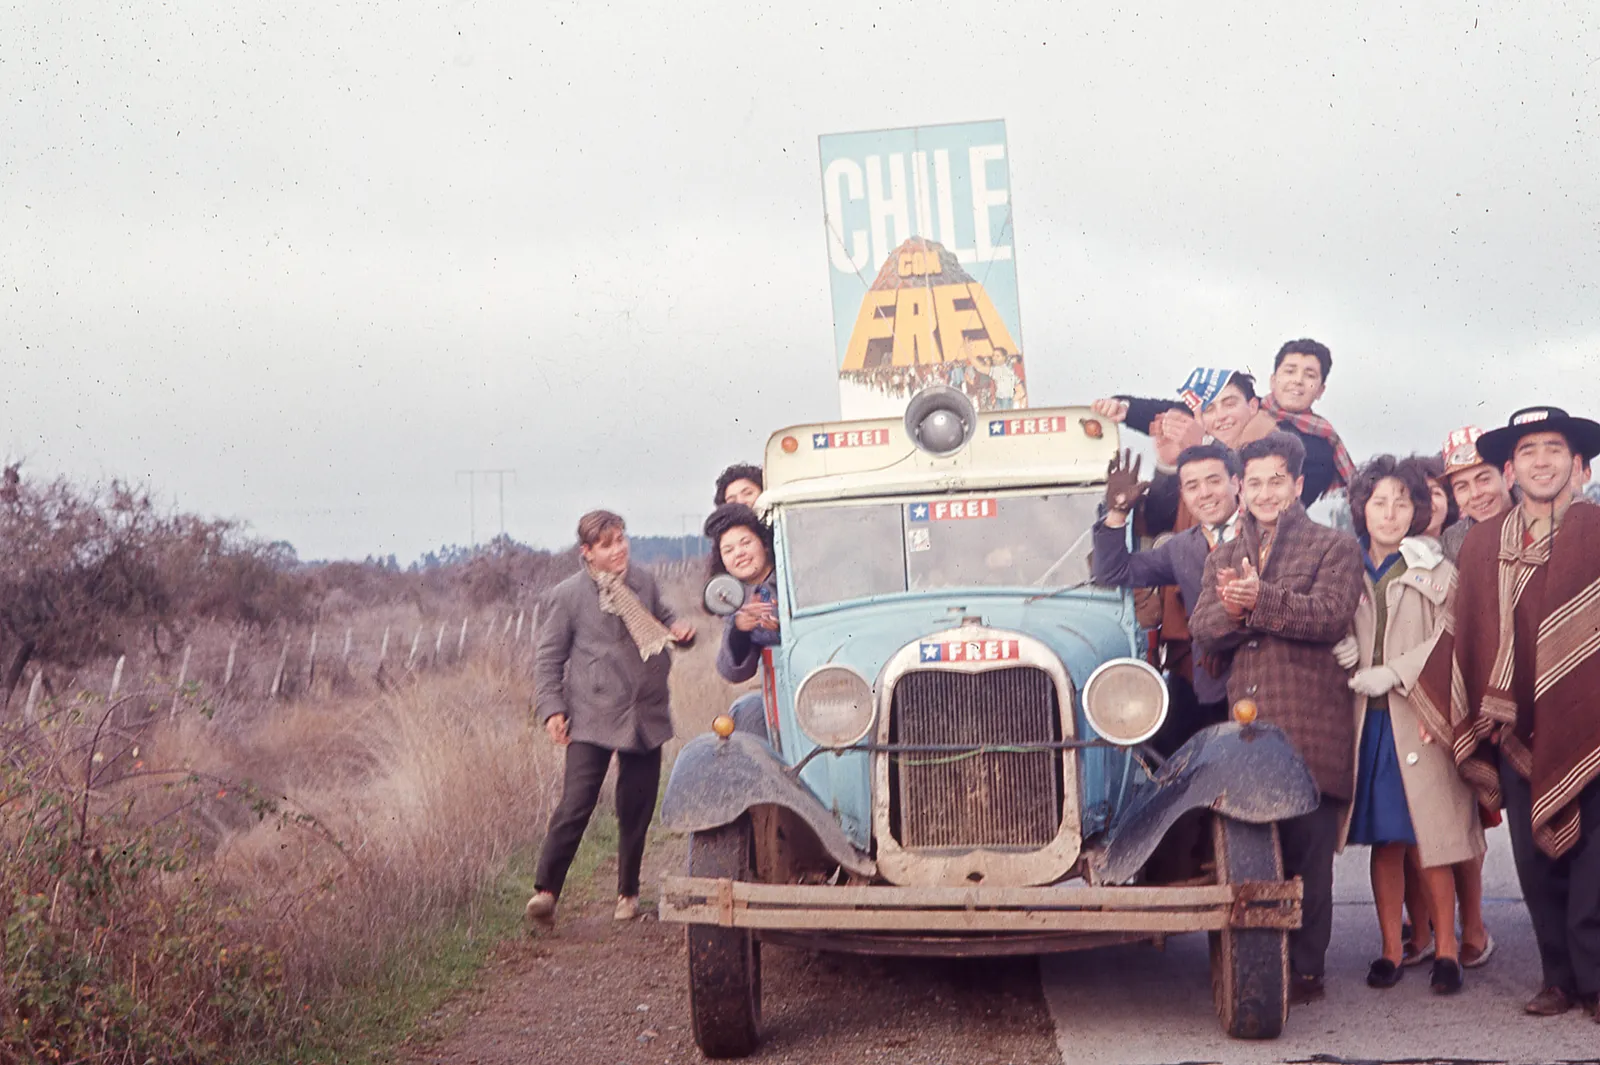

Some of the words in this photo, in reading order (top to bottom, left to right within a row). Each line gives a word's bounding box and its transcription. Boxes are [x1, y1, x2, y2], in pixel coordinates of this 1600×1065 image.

[823, 144, 1012, 274] CHILE
[840, 283, 1022, 371] FREI
[1010, 417, 1058, 434] FREI
[834, 430, 881, 447] FREI
[935, 500, 988, 518] FREI
[948, 640, 1010, 660] FREI
